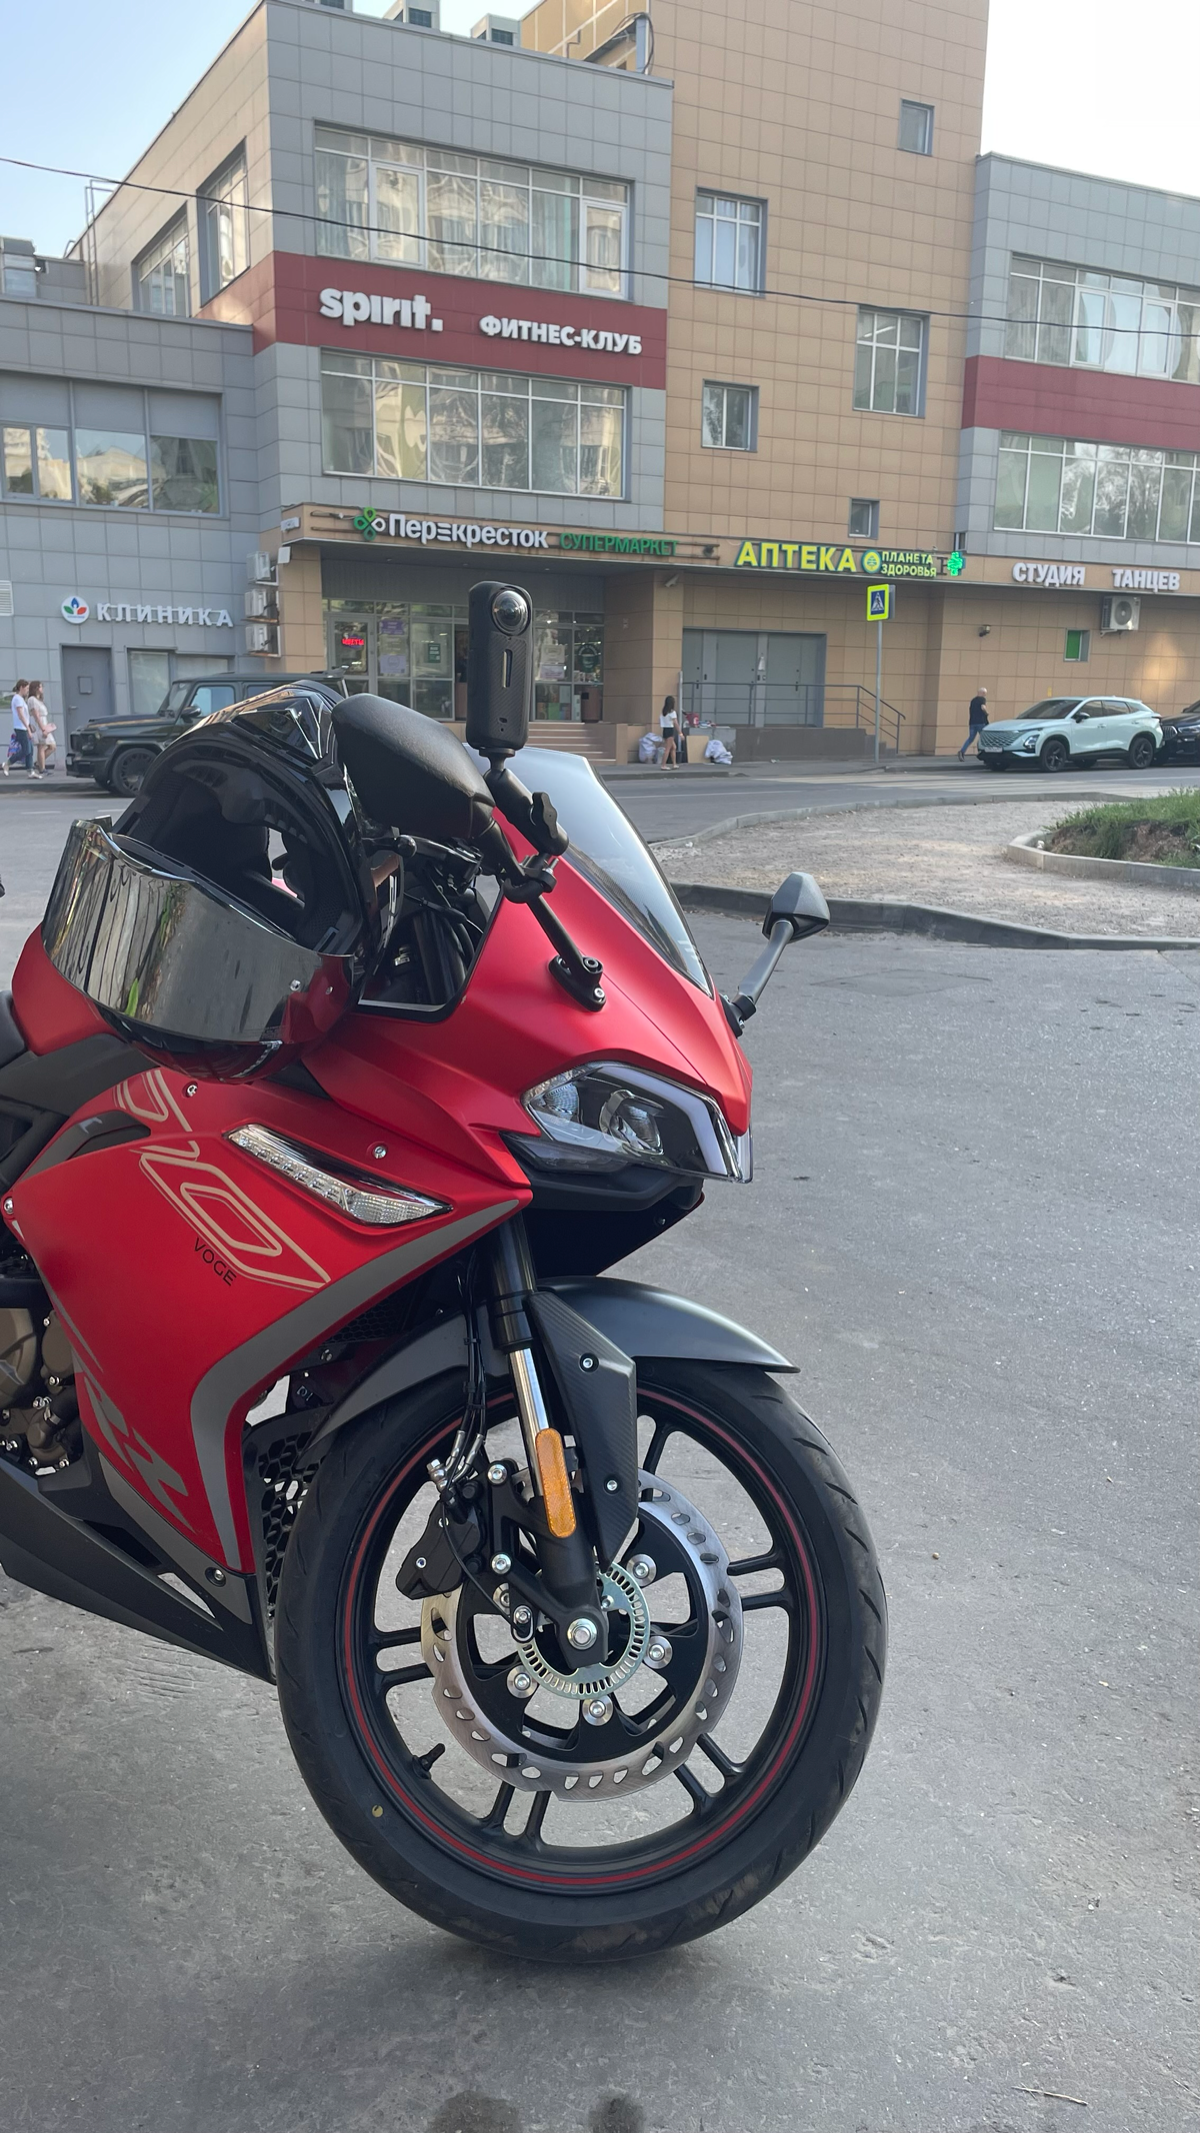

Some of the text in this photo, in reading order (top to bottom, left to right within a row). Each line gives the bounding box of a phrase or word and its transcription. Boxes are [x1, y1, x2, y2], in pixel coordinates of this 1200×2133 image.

[479, 314, 643, 355] ФИТНЕС-КЛУБ
[559, 532, 680, 556] СУПЕРМАРКЕТ
[735, 541, 857, 573] АПТЕКА
[882, 551, 934, 565] ПЛАНЕТА
[880, 563, 937, 578] ЗДОРОВЬЯ
[1012, 562, 1181, 593] СТУДИЯ ТАНЦЕВ
[96, 602, 234, 628] КЛИНИКА
[194, 1237, 237, 1287] VOGE
